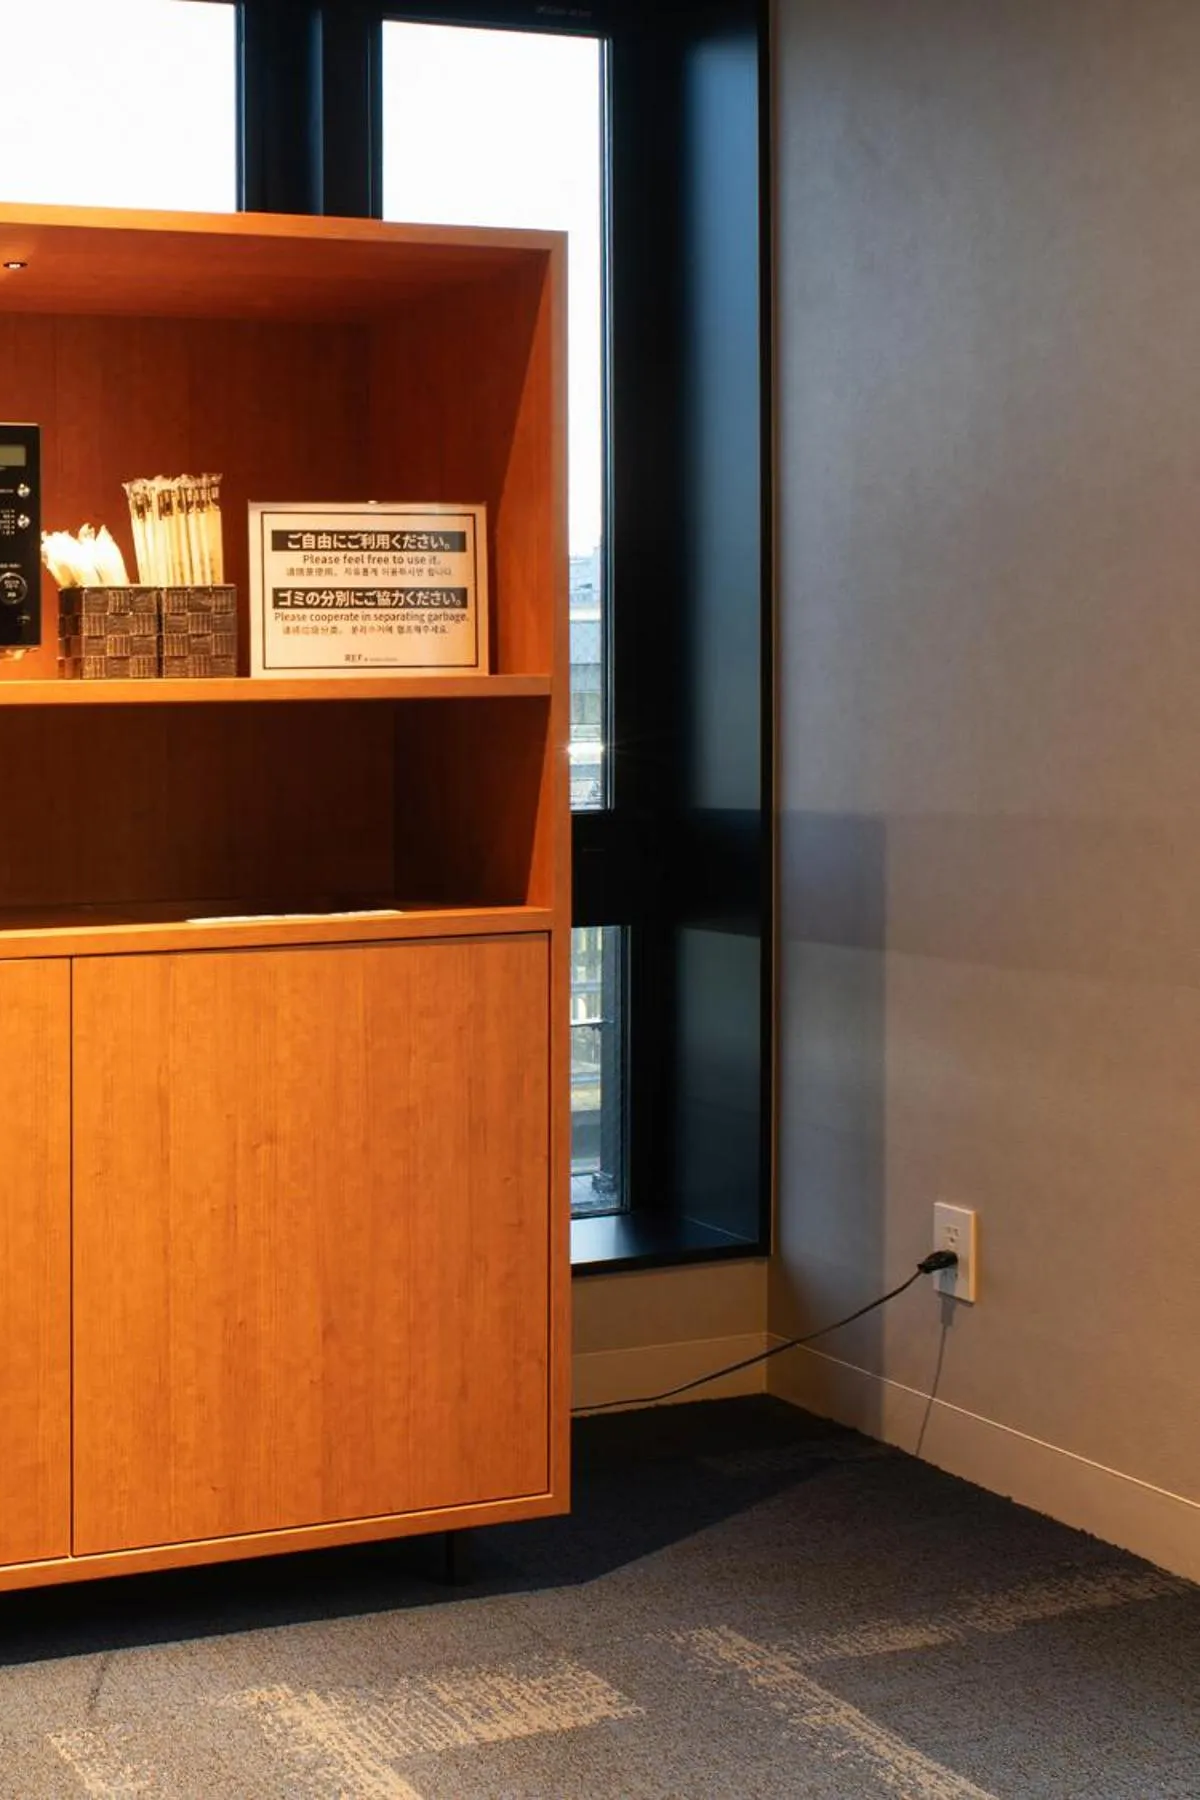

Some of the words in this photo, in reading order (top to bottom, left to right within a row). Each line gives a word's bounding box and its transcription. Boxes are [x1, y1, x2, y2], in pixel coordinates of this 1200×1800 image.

[287, 533, 450, 549] ご自由にご利用ください。
[303, 554, 340, 565] Please
[343, 554, 364, 565] feel
[367, 554, 389, 565] free
[393, 555, 404, 565] to
[407, 555, 427, 565] use
[278, 590, 462, 607] ゴミの分別にご協力ください。
[274, 612, 307, 622] Please
[310, 612, 359, 624] cooperate
[361, 612, 371, 622] in
[374, 612, 425, 624] separating
